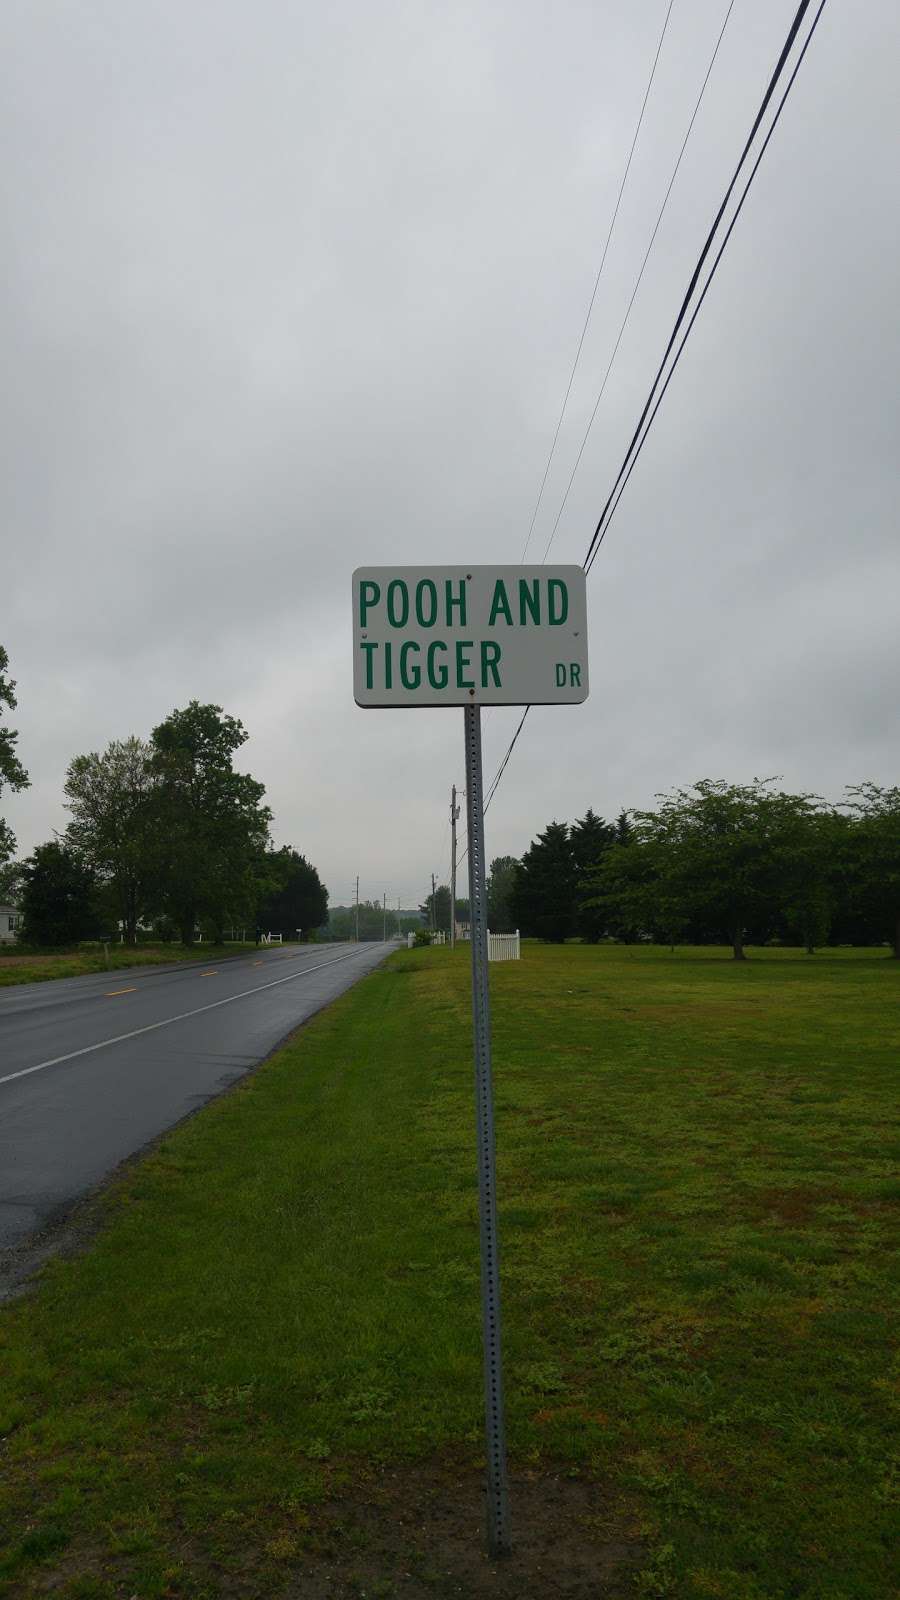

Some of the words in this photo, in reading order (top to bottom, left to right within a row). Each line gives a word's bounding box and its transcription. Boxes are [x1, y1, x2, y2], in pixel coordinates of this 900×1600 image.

[359, 579, 467, 628] POOH
[488, 579, 569, 626] AND
[360, 640, 502, 690] TIGGER
[555, 663, 582, 688] DR
